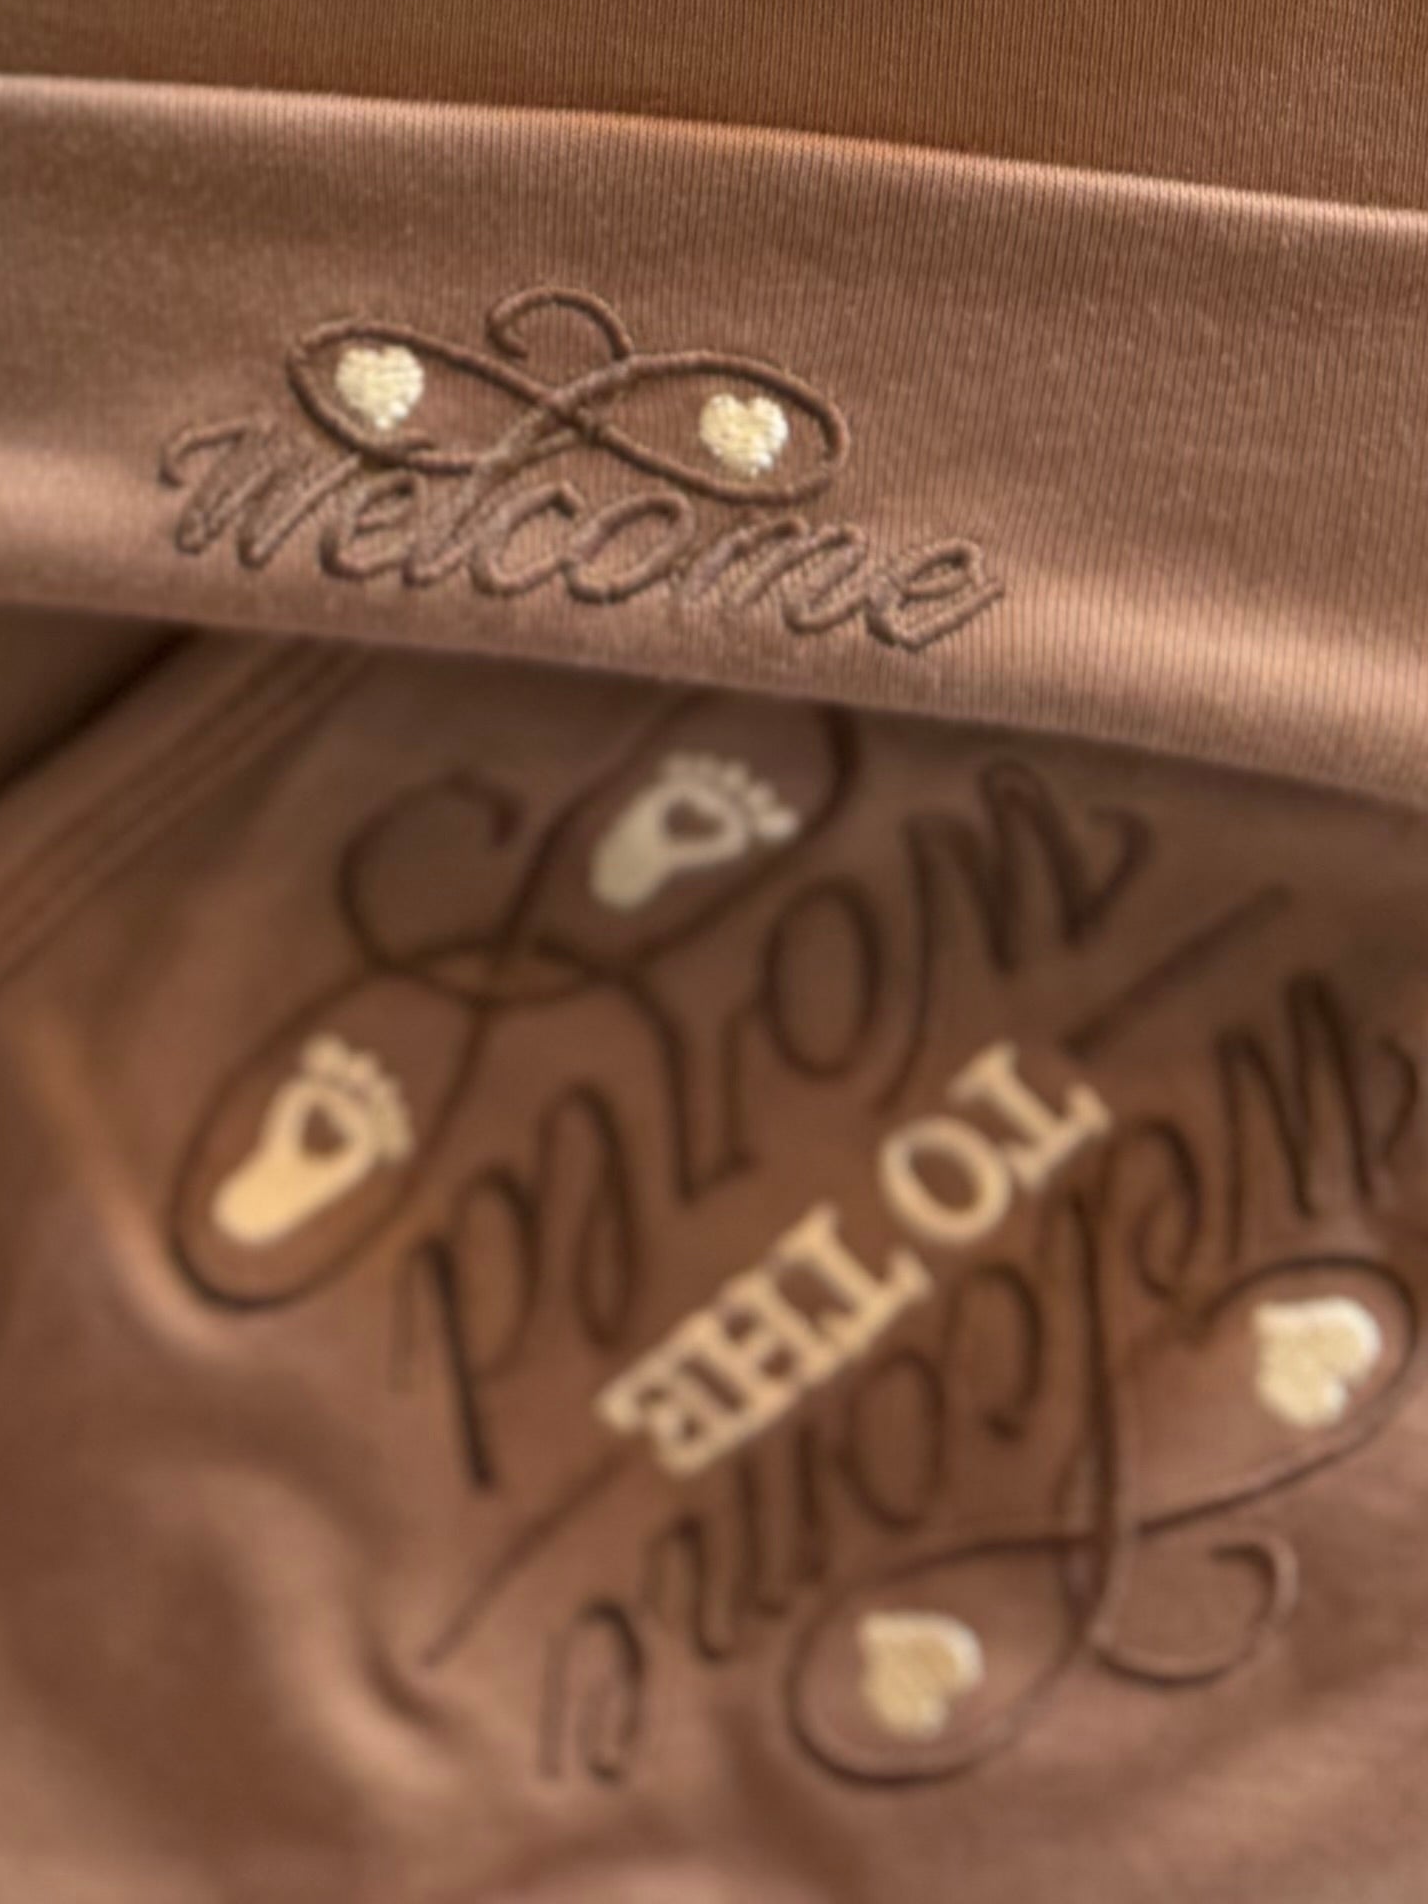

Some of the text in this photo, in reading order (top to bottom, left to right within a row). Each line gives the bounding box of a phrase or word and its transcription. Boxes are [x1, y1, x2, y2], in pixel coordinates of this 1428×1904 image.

[158, 414, 1006, 652] Welcome
[594, 1042, 1114, 1477] TO THE
